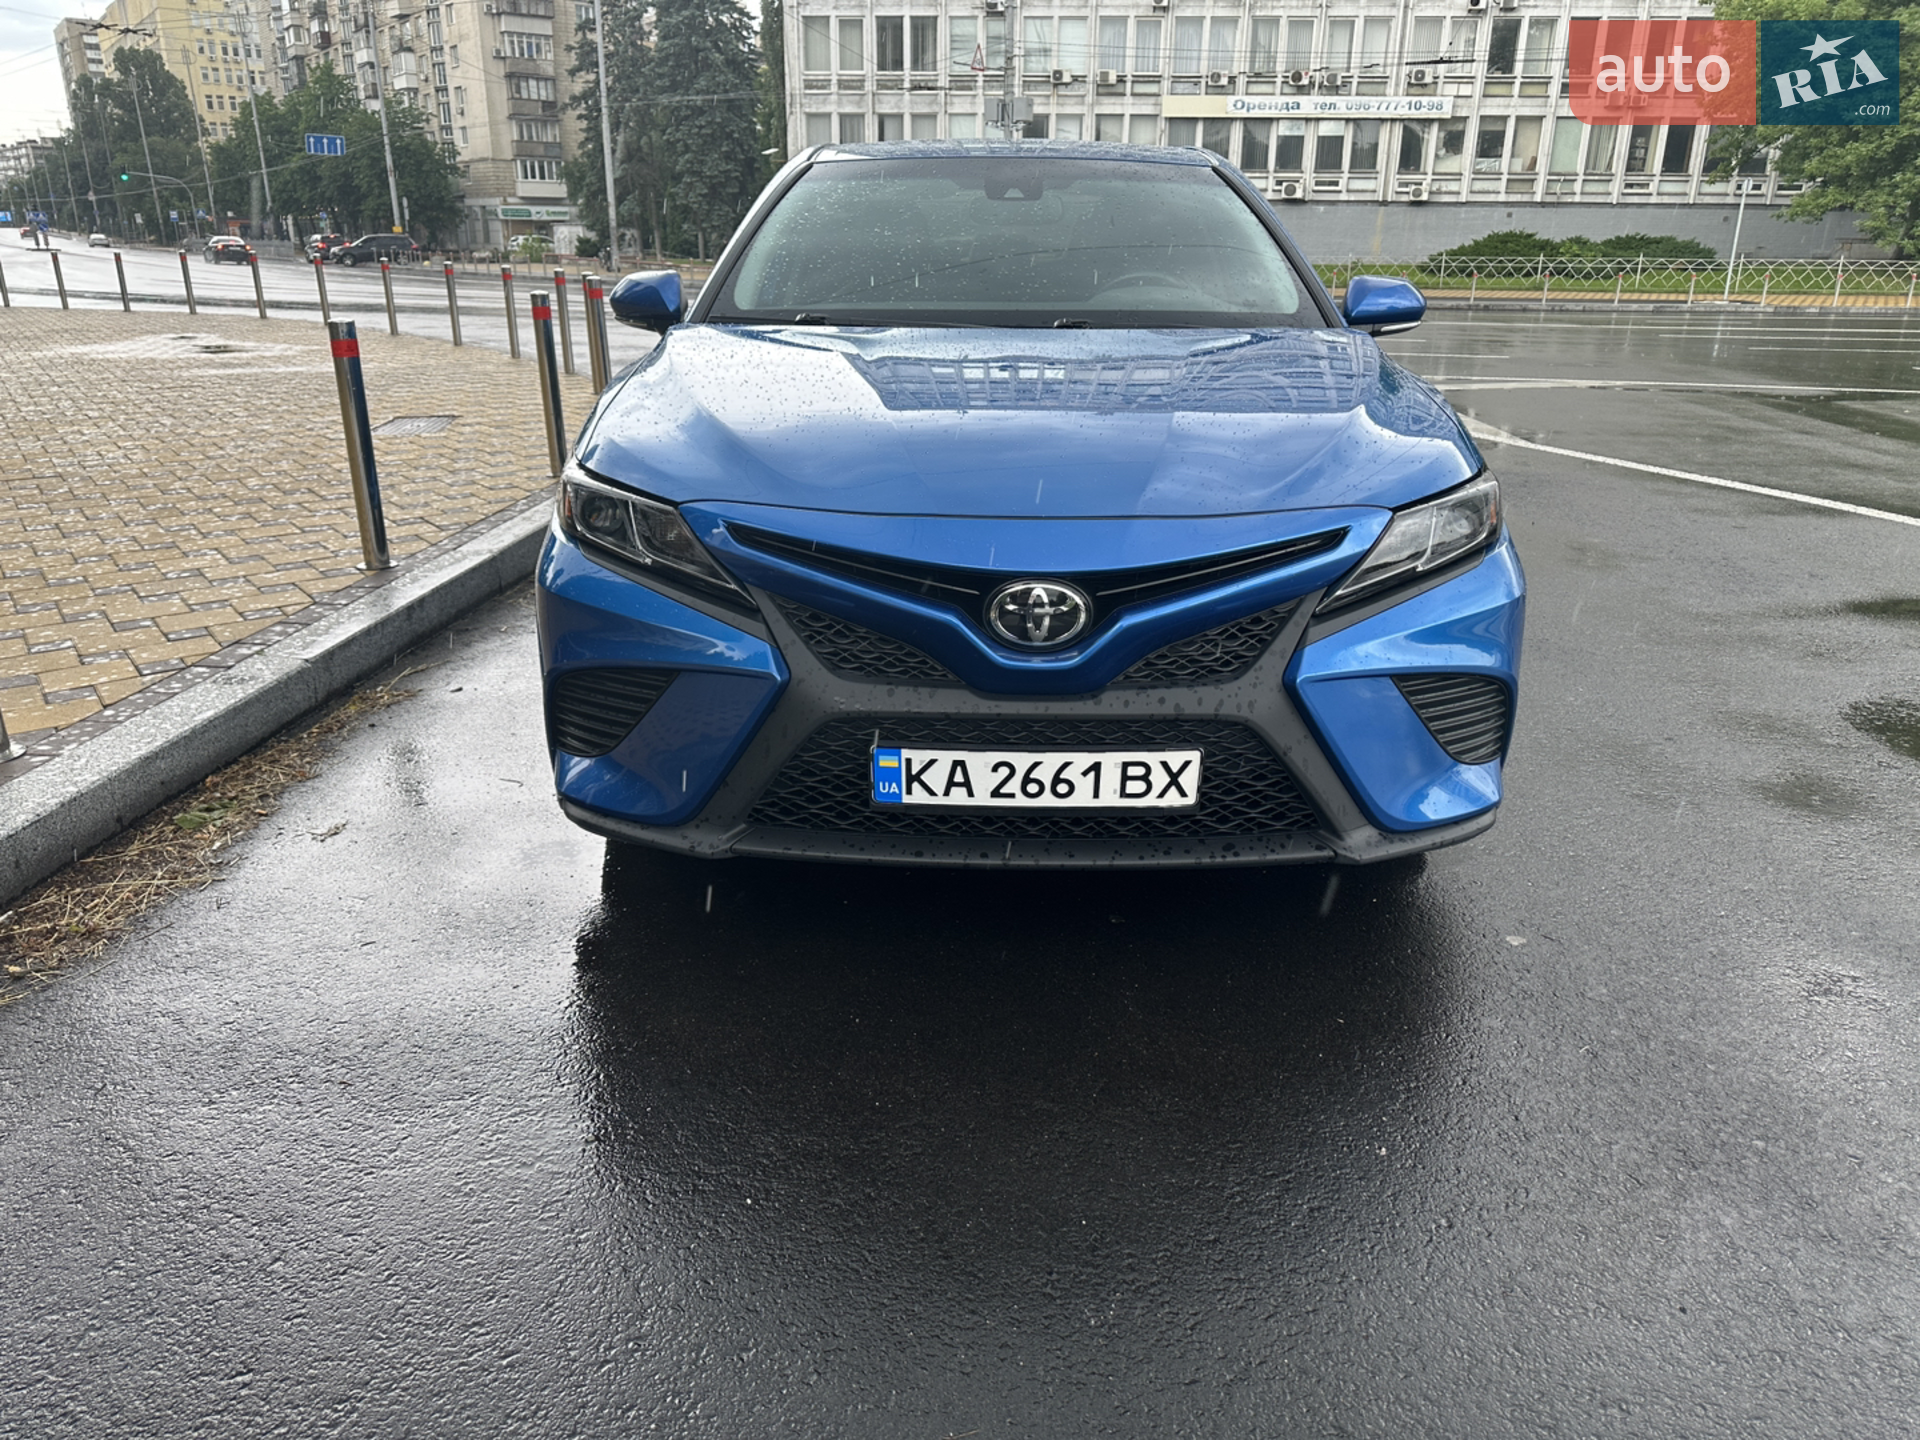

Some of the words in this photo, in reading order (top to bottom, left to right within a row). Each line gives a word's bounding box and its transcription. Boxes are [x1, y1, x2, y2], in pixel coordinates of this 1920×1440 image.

[1232, 99, 1301, 113] Оренда
[1313, 101, 1341, 111] тел.
[1345, 100, 1444, 111] 096-777-10-98
[904, 757, 975, 798] KA
[989, 760, 1102, 799] 2661
[1118, 760, 1193, 799] BX
[879, 781, 899, 794] UA
